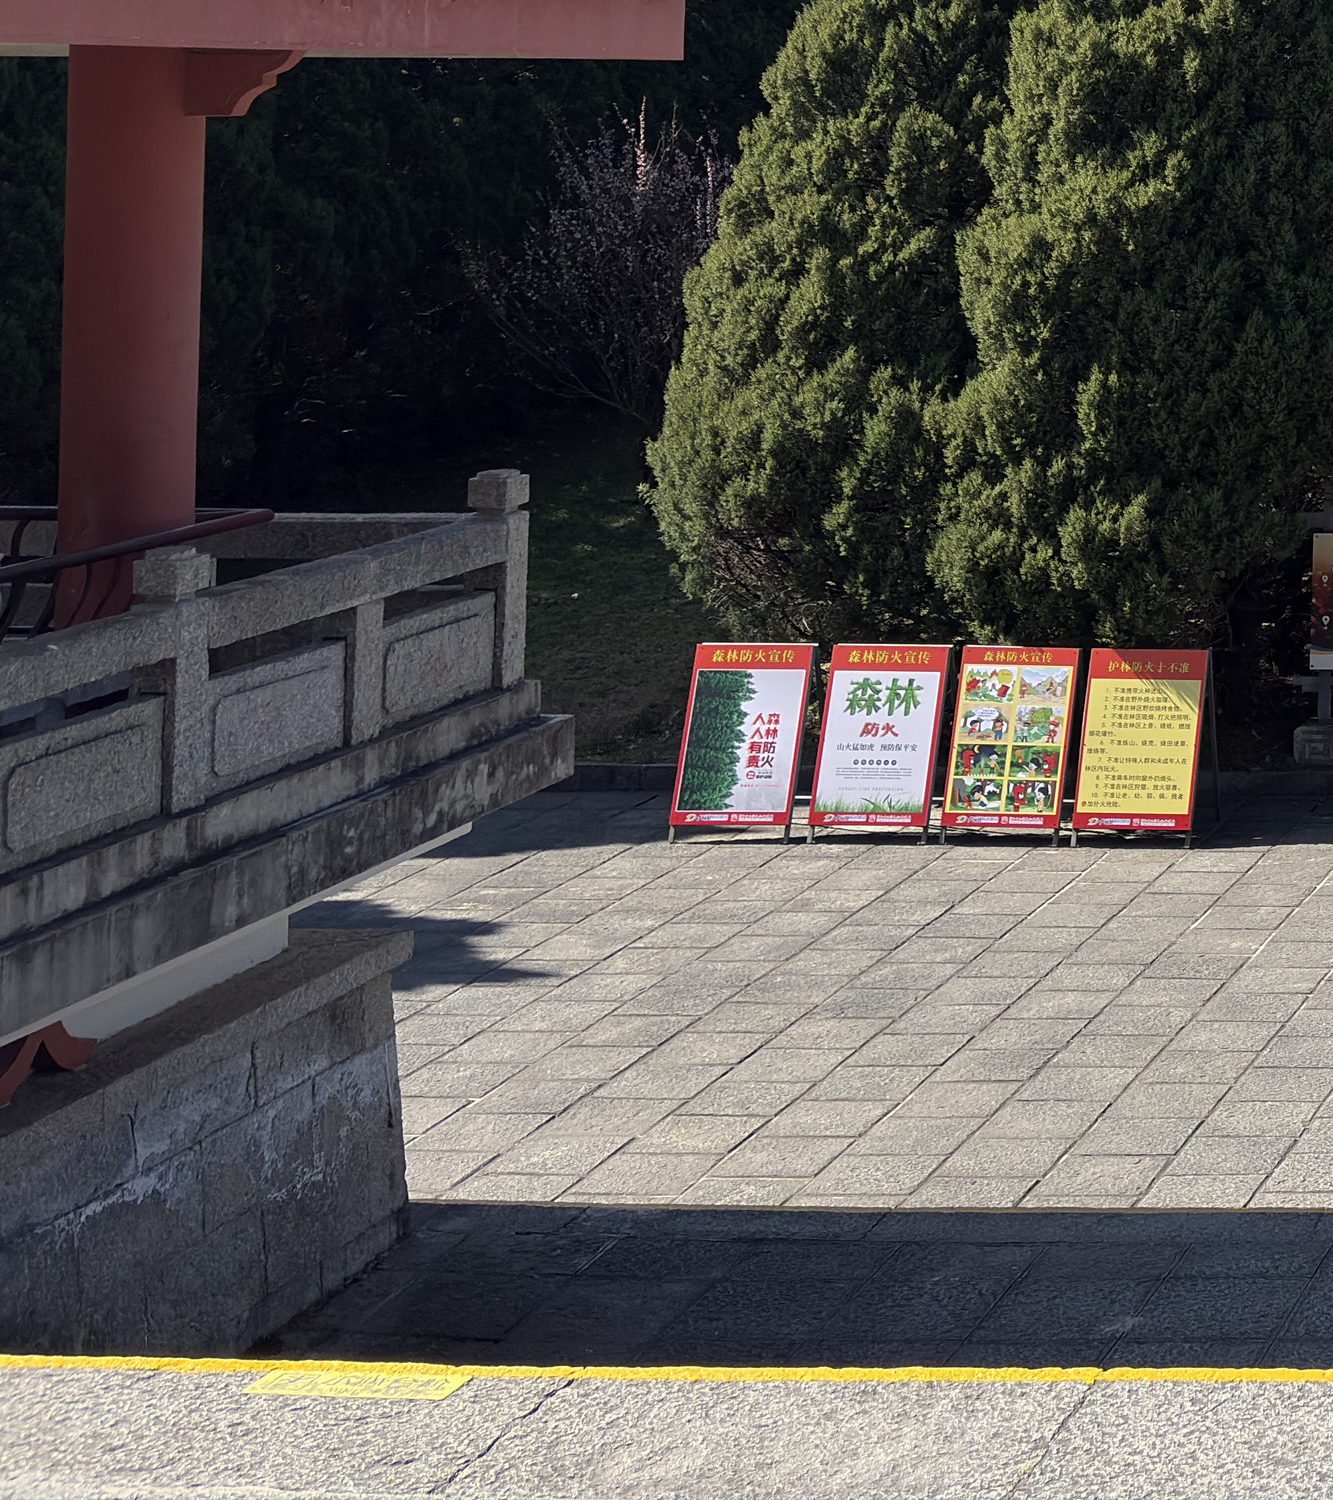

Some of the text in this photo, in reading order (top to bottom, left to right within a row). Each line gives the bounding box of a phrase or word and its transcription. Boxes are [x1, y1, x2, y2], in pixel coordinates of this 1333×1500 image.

[712, 649, 795, 663] 森林防火宣传
[849, 650, 931, 664] 森林防火宣传
[984, 651, 1053, 663] 森林防火宣传
[1108, 660, 1190, 673] 护林防火十不准
[843, 677, 924, 716] 森林
[859, 722, 899, 737] 防火
[745, 713, 765, 768] 人人有责
[760, 713, 780, 768] 森林防火
[836, 742, 918, 752] 山火猛如虎 预防保平安
